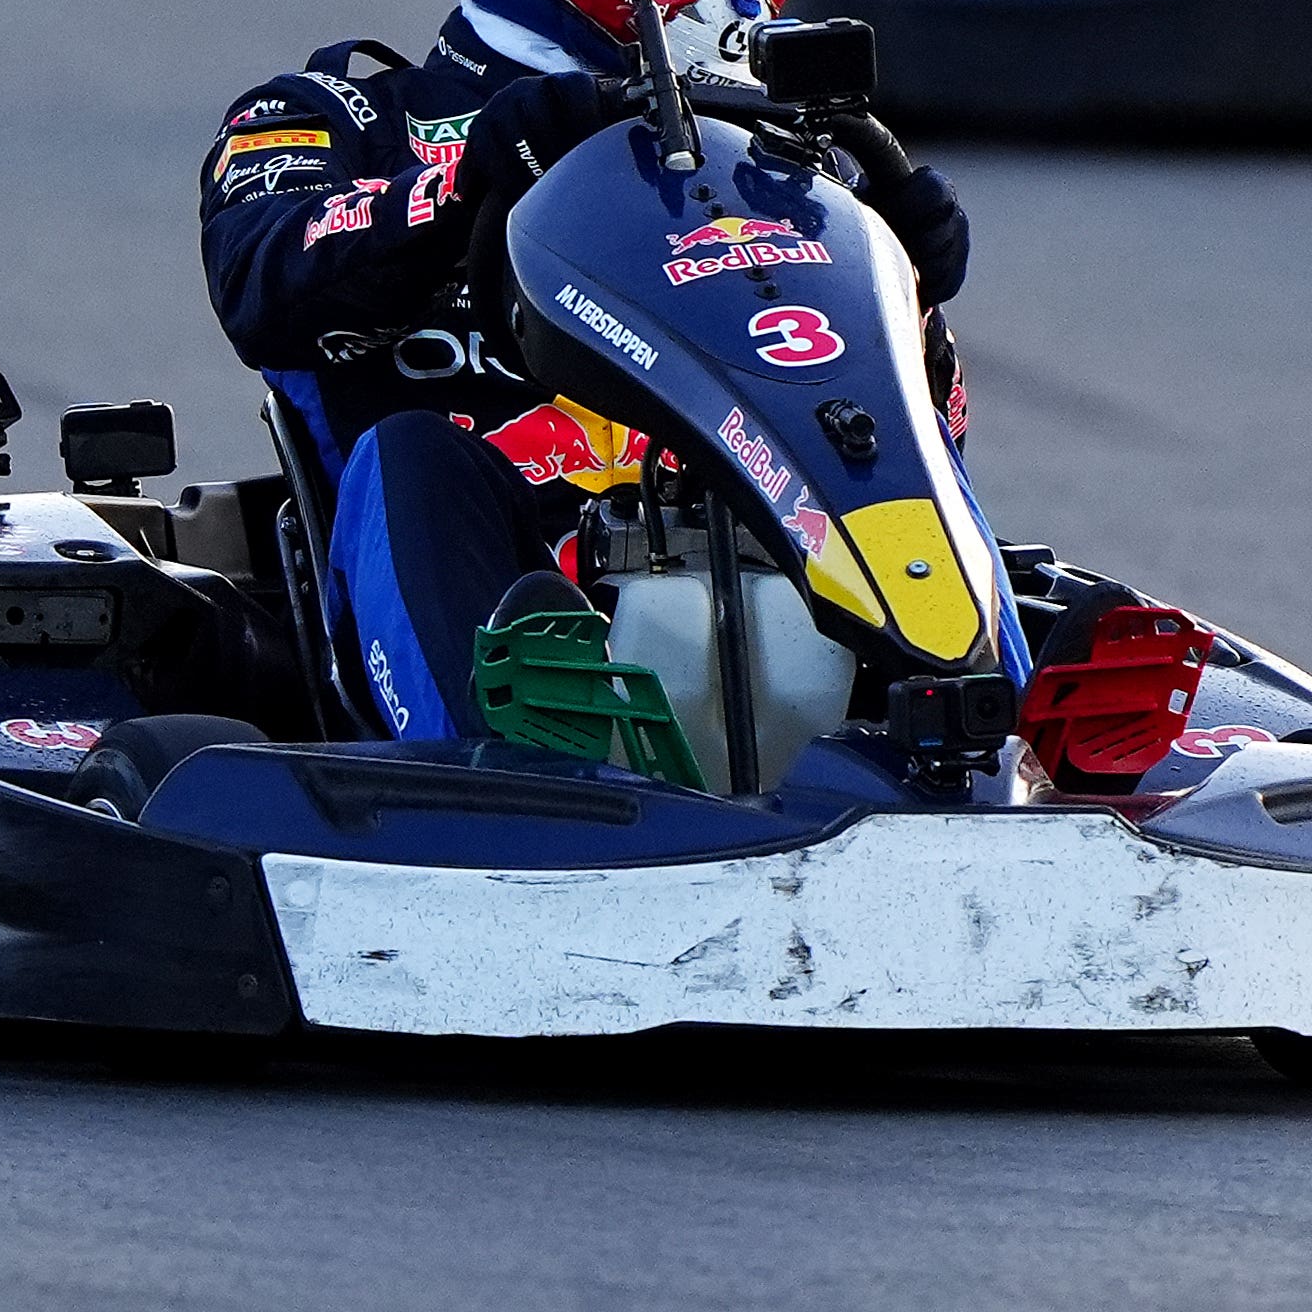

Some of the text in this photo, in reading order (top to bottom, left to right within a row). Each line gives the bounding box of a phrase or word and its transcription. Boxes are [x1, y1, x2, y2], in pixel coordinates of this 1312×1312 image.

[663, 240, 833, 286] Red Bull
[554, 283, 660, 372] M.VERSTAPPEN
[748, 305, 846, 368] 3
[717, 406, 792, 504] Red Bull
